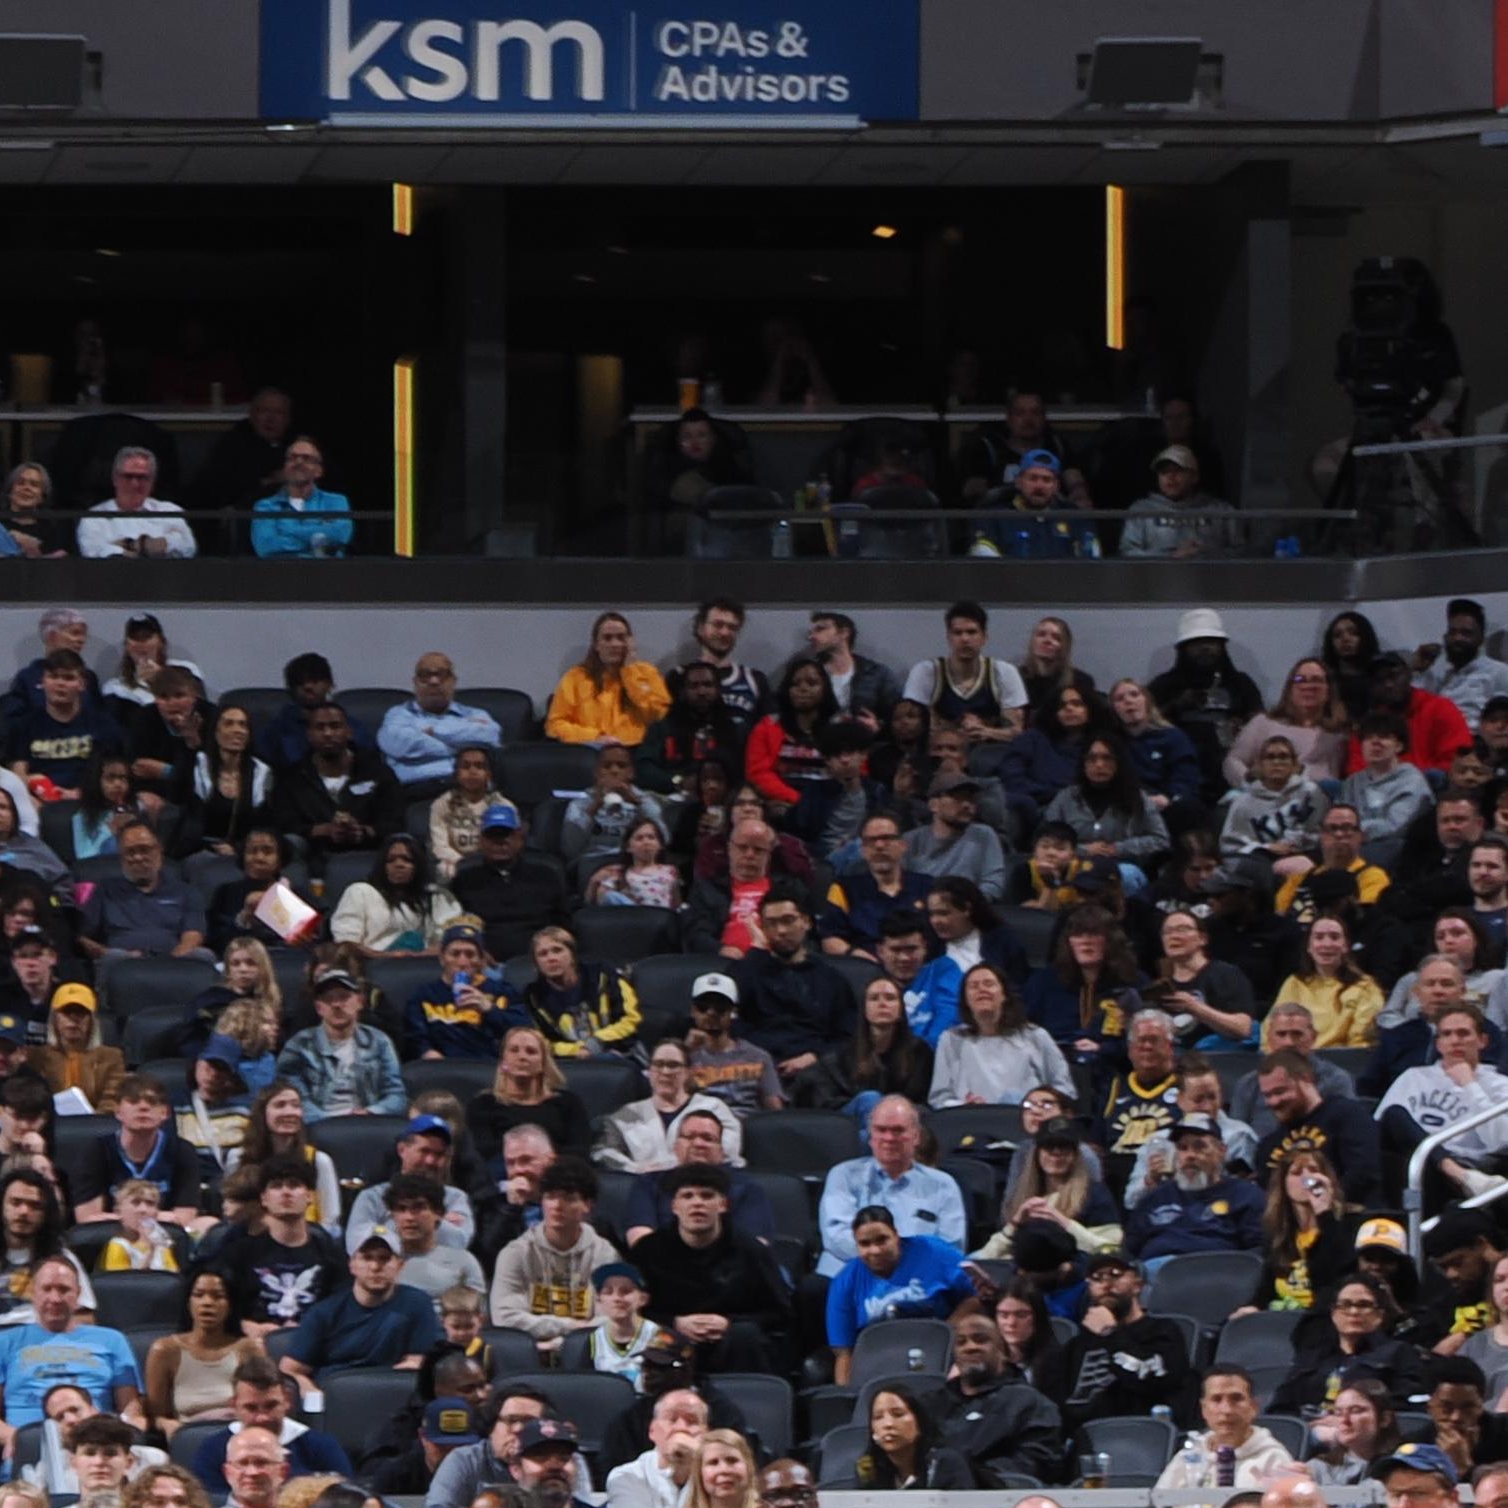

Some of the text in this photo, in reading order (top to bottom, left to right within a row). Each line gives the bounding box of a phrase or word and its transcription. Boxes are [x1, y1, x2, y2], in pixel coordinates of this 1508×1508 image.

[328, 0, 605, 101] ksm
[660, 21, 809, 58] CPAs &
[659, 65, 851, 102] Advisors
